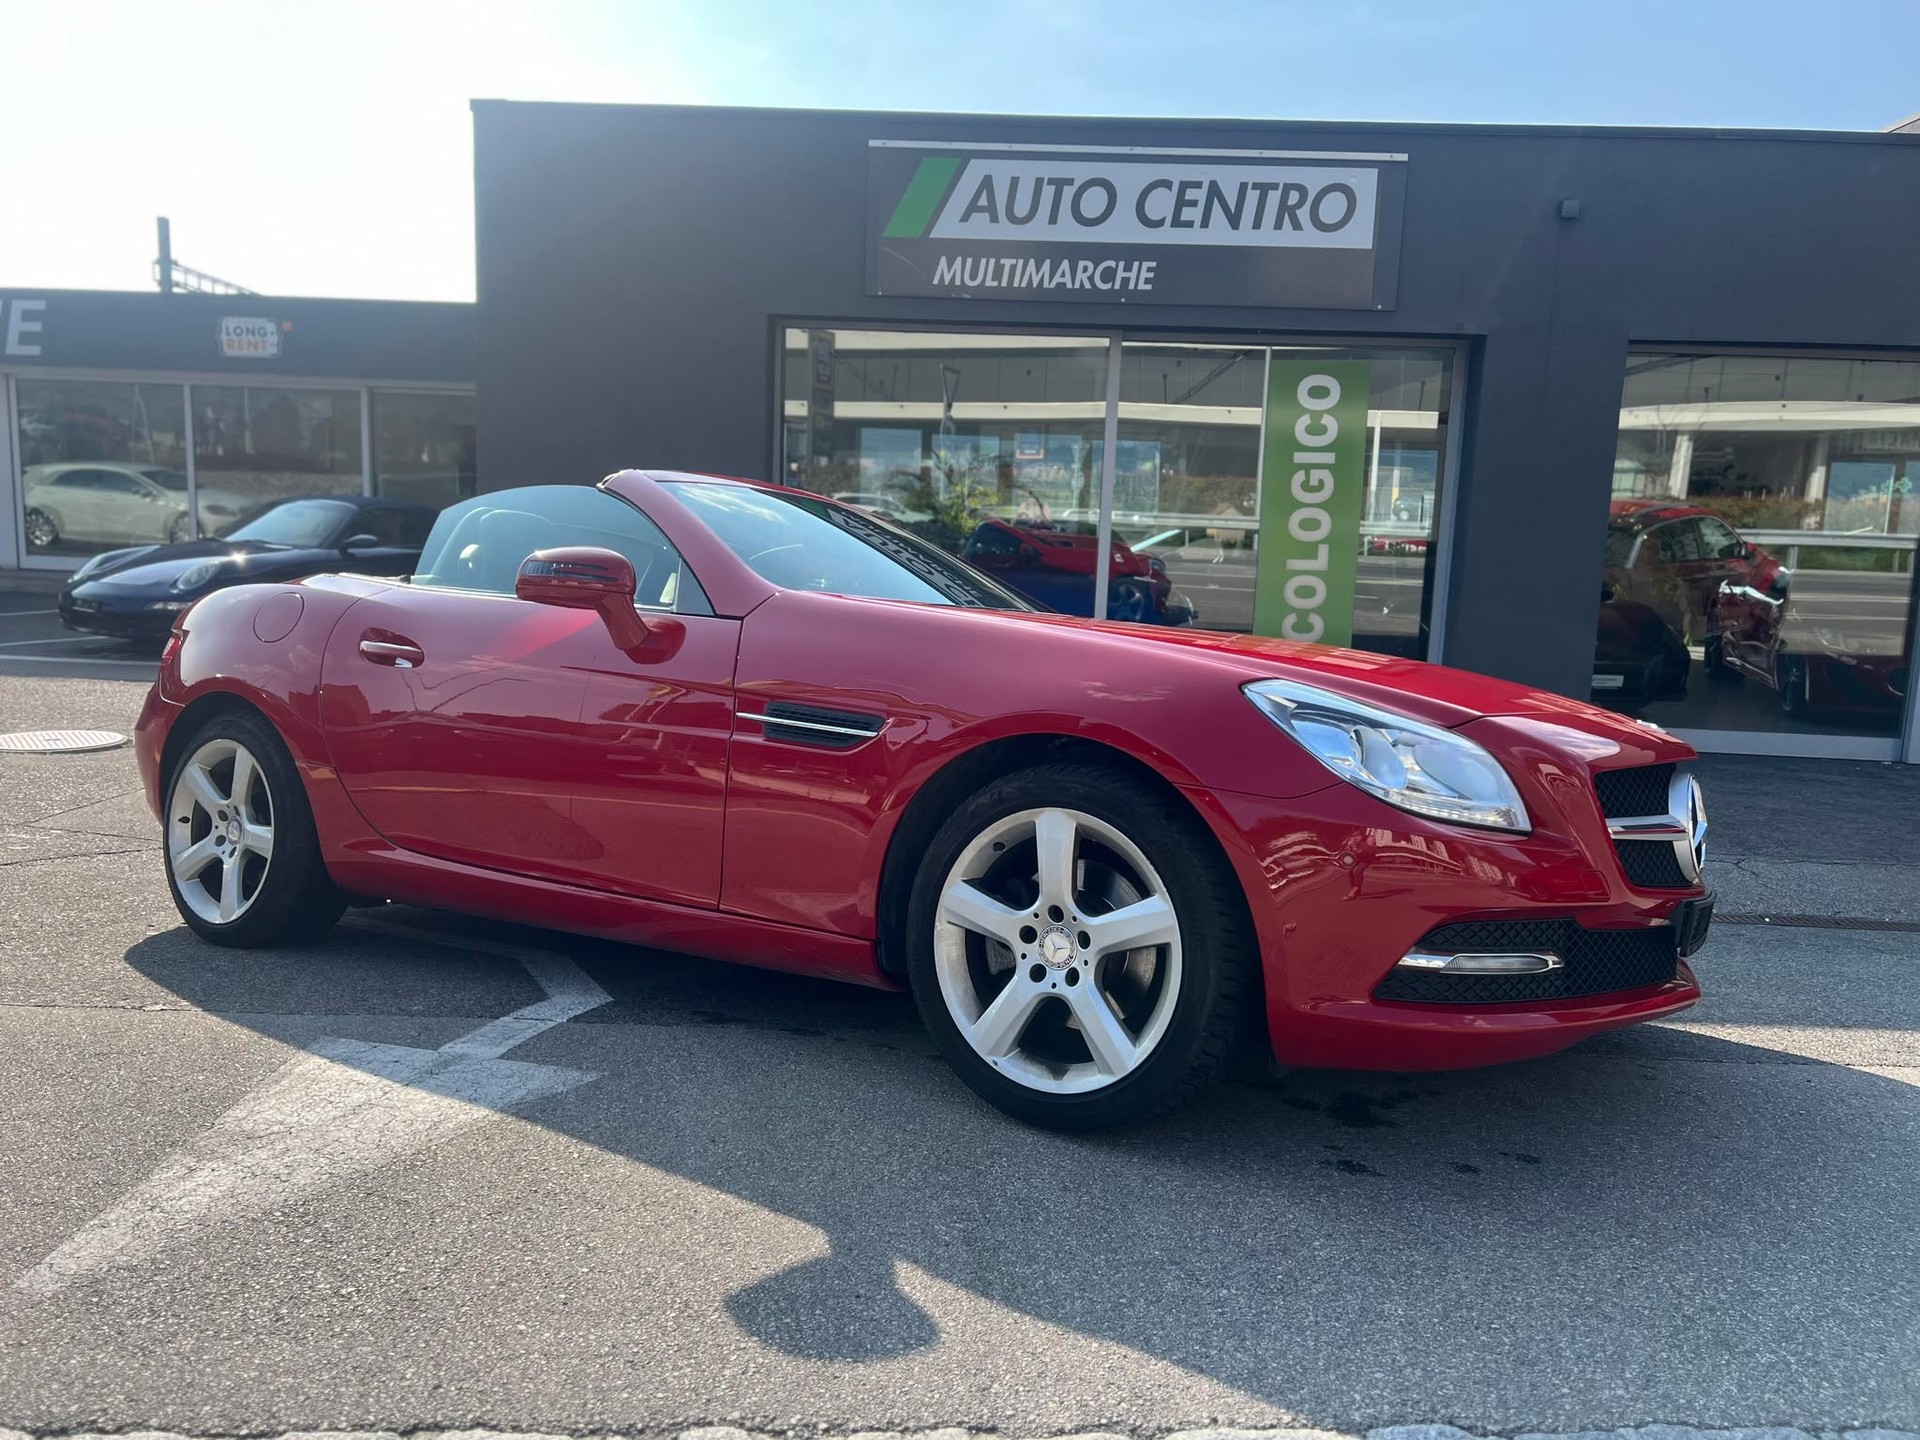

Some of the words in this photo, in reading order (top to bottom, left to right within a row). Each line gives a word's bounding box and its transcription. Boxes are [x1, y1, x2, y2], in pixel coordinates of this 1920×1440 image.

[958, 174, 1118, 228] AUTO
[1134, 178, 1358, 234] CENTRO
[932, 255, 1157, 291] MULTIMARCHE
[0, 299, 47, 355] E
